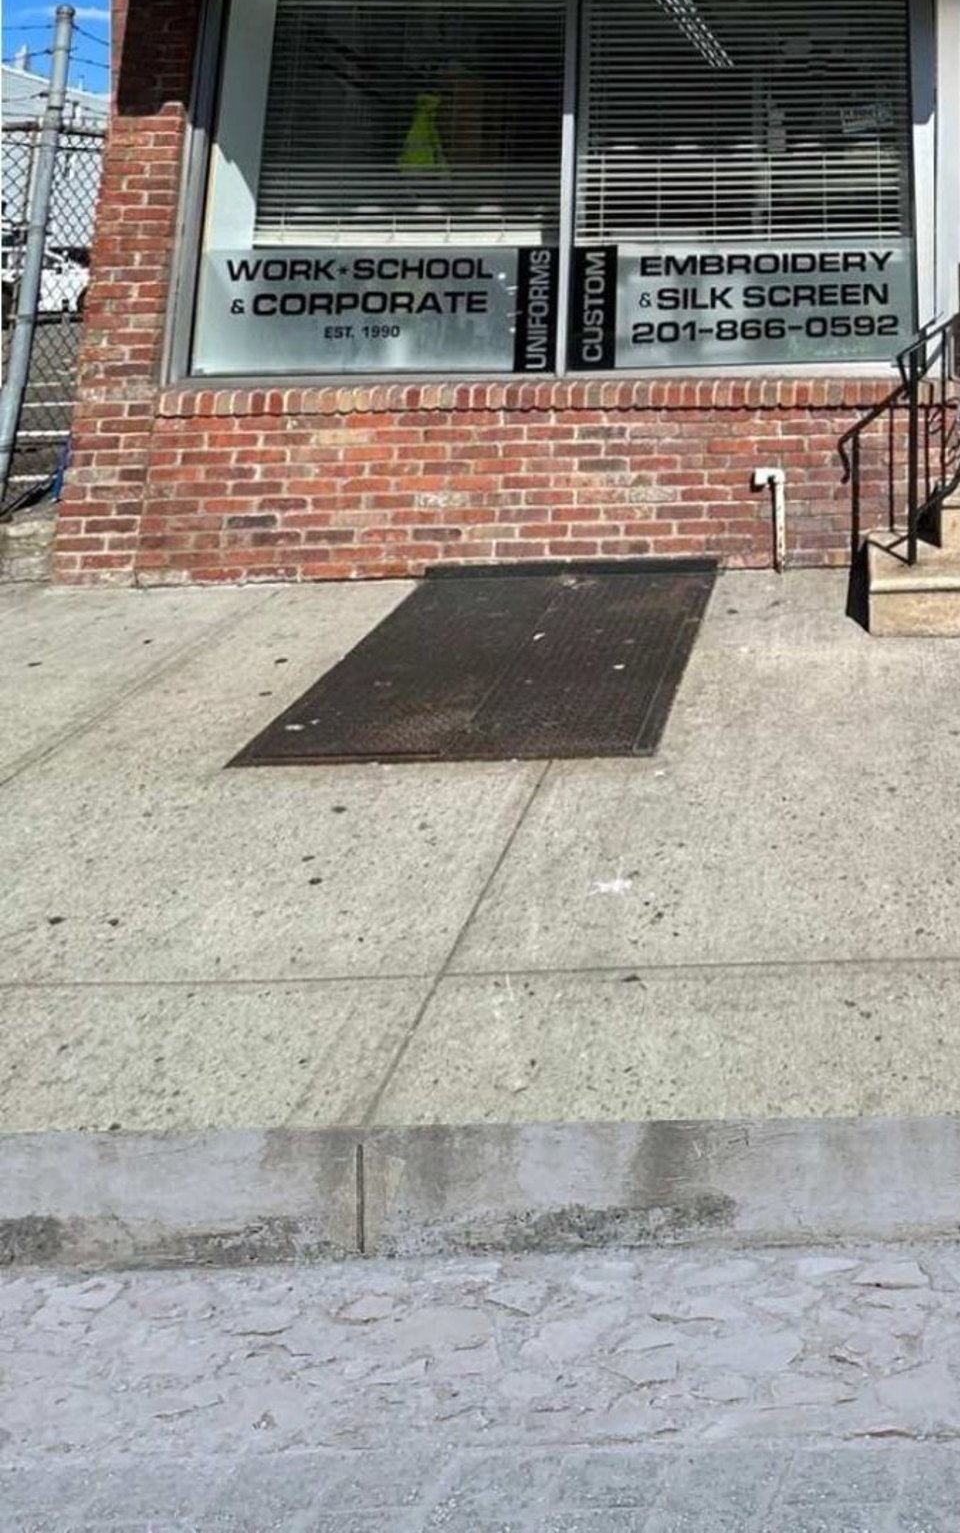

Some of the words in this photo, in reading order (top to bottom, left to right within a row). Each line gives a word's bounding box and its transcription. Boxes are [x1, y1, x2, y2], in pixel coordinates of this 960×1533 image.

[353, 257, 494, 280] SCHOOL
[640, 251, 894, 277] EMBROIDERY
[252, 291, 489, 316] CORPORATE
[525, 249, 550, 369] UNIFORMS
[582, 251, 606, 363] CUSTOM
[657, 286, 733, 310] SILK
[743, 283, 889, 308] SCREEN
[362, 325, 400, 338] 1990
[632, 315, 898, 345] 201-866-0592
